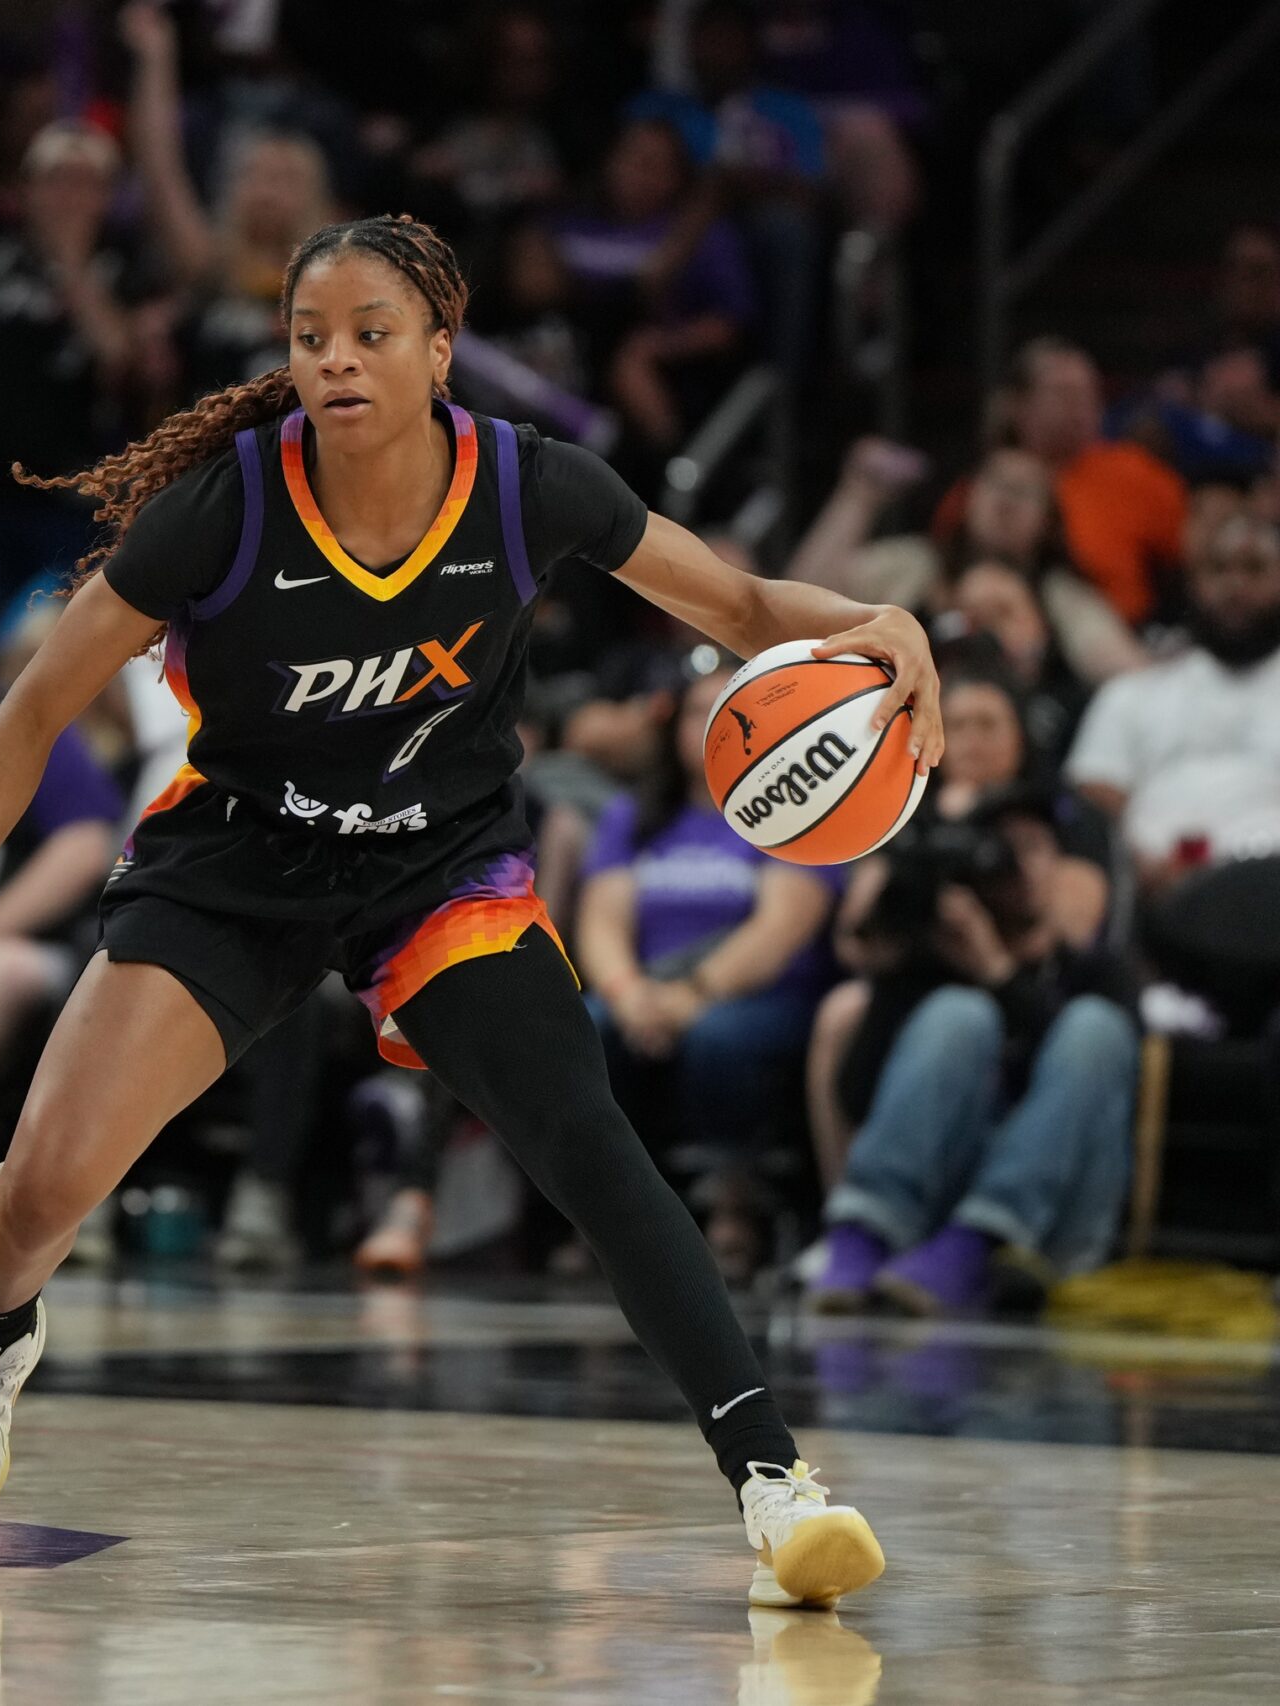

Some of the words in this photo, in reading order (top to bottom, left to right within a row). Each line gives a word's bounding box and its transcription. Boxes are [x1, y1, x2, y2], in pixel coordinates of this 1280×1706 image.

[280, 619, 486, 713] PHX
[387, 807, 417, 822] STORES
[734, 731, 857, 829] Wilson
